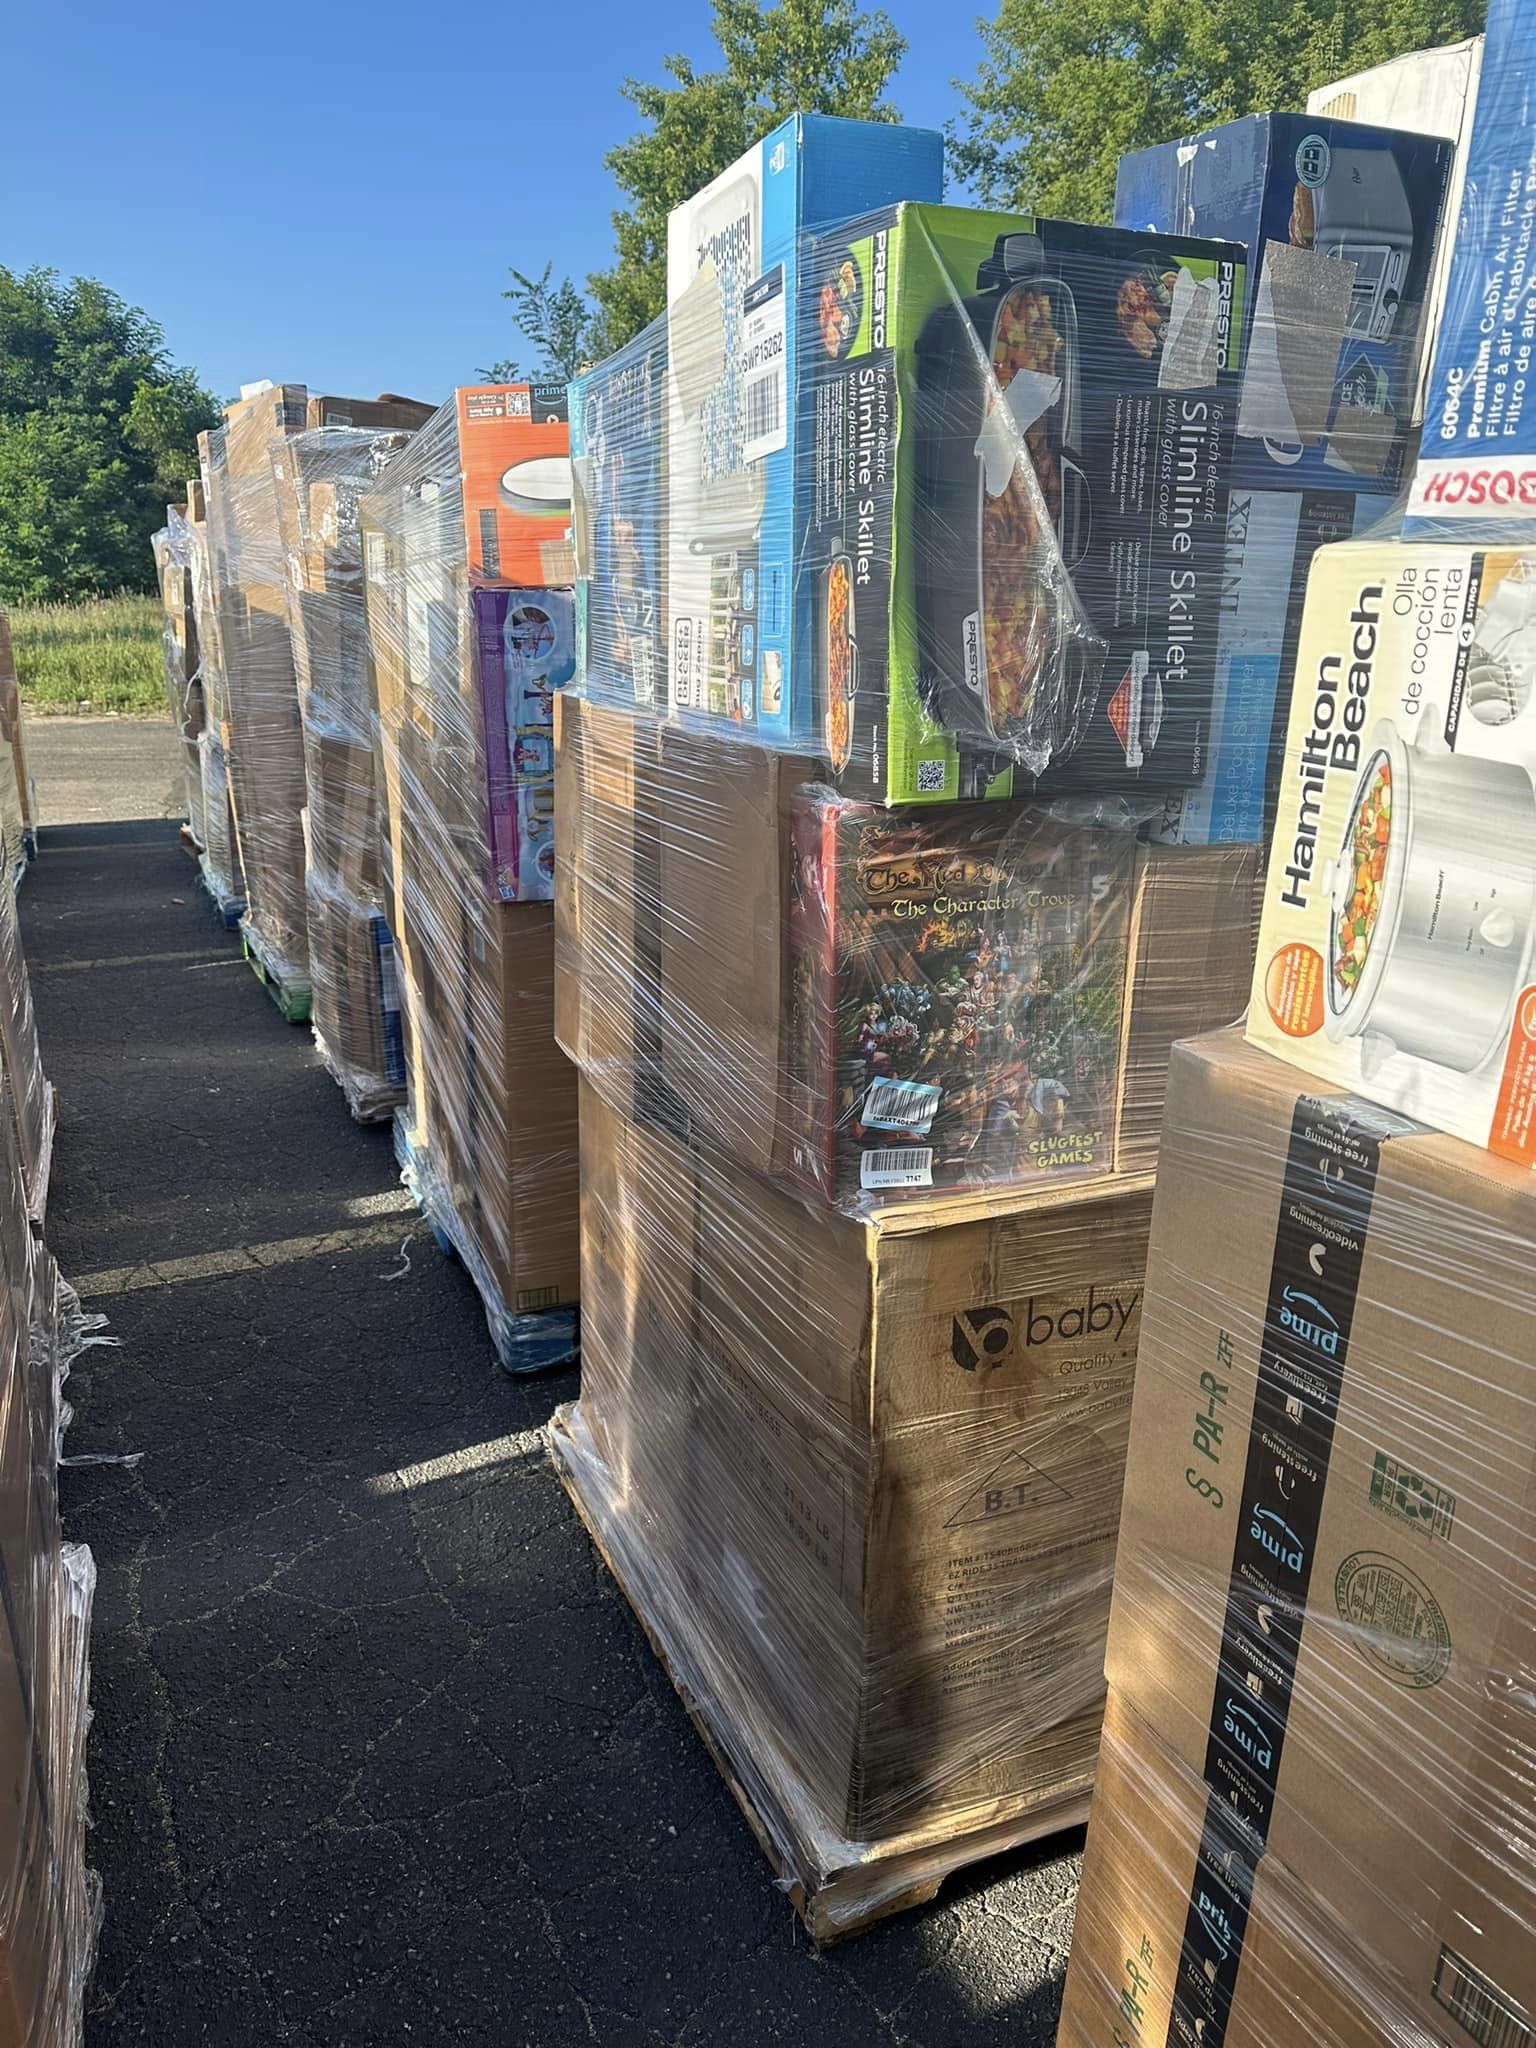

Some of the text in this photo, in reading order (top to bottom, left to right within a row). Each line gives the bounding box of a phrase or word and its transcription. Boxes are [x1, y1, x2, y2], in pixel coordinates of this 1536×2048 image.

[1502, 199, 1536, 321] d'habitacle
[873, 230, 887, 349] PRESTO
[1216, 262, 1233, 369] PRESTO
[1467, 168, 1523, 439] Premium Cabin Air Filter
[1519, 296, 1536, 339] aire
[1493, 362, 1510, 376] à
[1497, 328, 1513, 357] air
[1514, 345, 1531, 373] de
[534, 385, 568, 398] prime
[1115, 399, 1123, 430] Doubles
[1124, 399, 1133, 436] Luxurious
[1441, 366, 1464, 440] 6064C
[1485, 382, 1506, 437] Filtre
[1503, 379, 1526, 436] Filtro
[847, 372, 858, 493] with glass cover
[876, 367, 890, 483] 16-inch electric
[1120, 437, 1131, 474] tempered
[1158, 397, 1178, 528] with glass cover
[1203, 404, 1224, 523] 16-inch electric
[1119, 475, 1129, 493] glass
[857, 500, 874, 585] Skillet
[1393, 567, 1418, 616] Olla
[1433, 568, 1464, 636] lenta
[966, 620, 978, 686] PRESTO
[1165, 570, 1196, 680] Skillet
[1401, 568, 1441, 716] de cocción
[1447, 578, 1479, 733] CAPACIDAD DE 4 LITROS
[1281, 655, 1343, 909] Hamilton
[1219, 785, 1240, 840] Deluxe
[861, 863, 915, 895] The
[891, 888, 1077, 918] The Character Trove
[1427, 901, 1441, 940] Hamilton
[1028, 1131, 1104, 1155] SLUGFEST
[1036, 1149, 1093, 1168] GAMES
[1026, 1286, 1143, 1347] baby
[1059, 1351, 1116, 1376] Quality
[1192, 1371, 1229, 1465] PA-R
[984, 1482, 1038, 1513] B.T.
